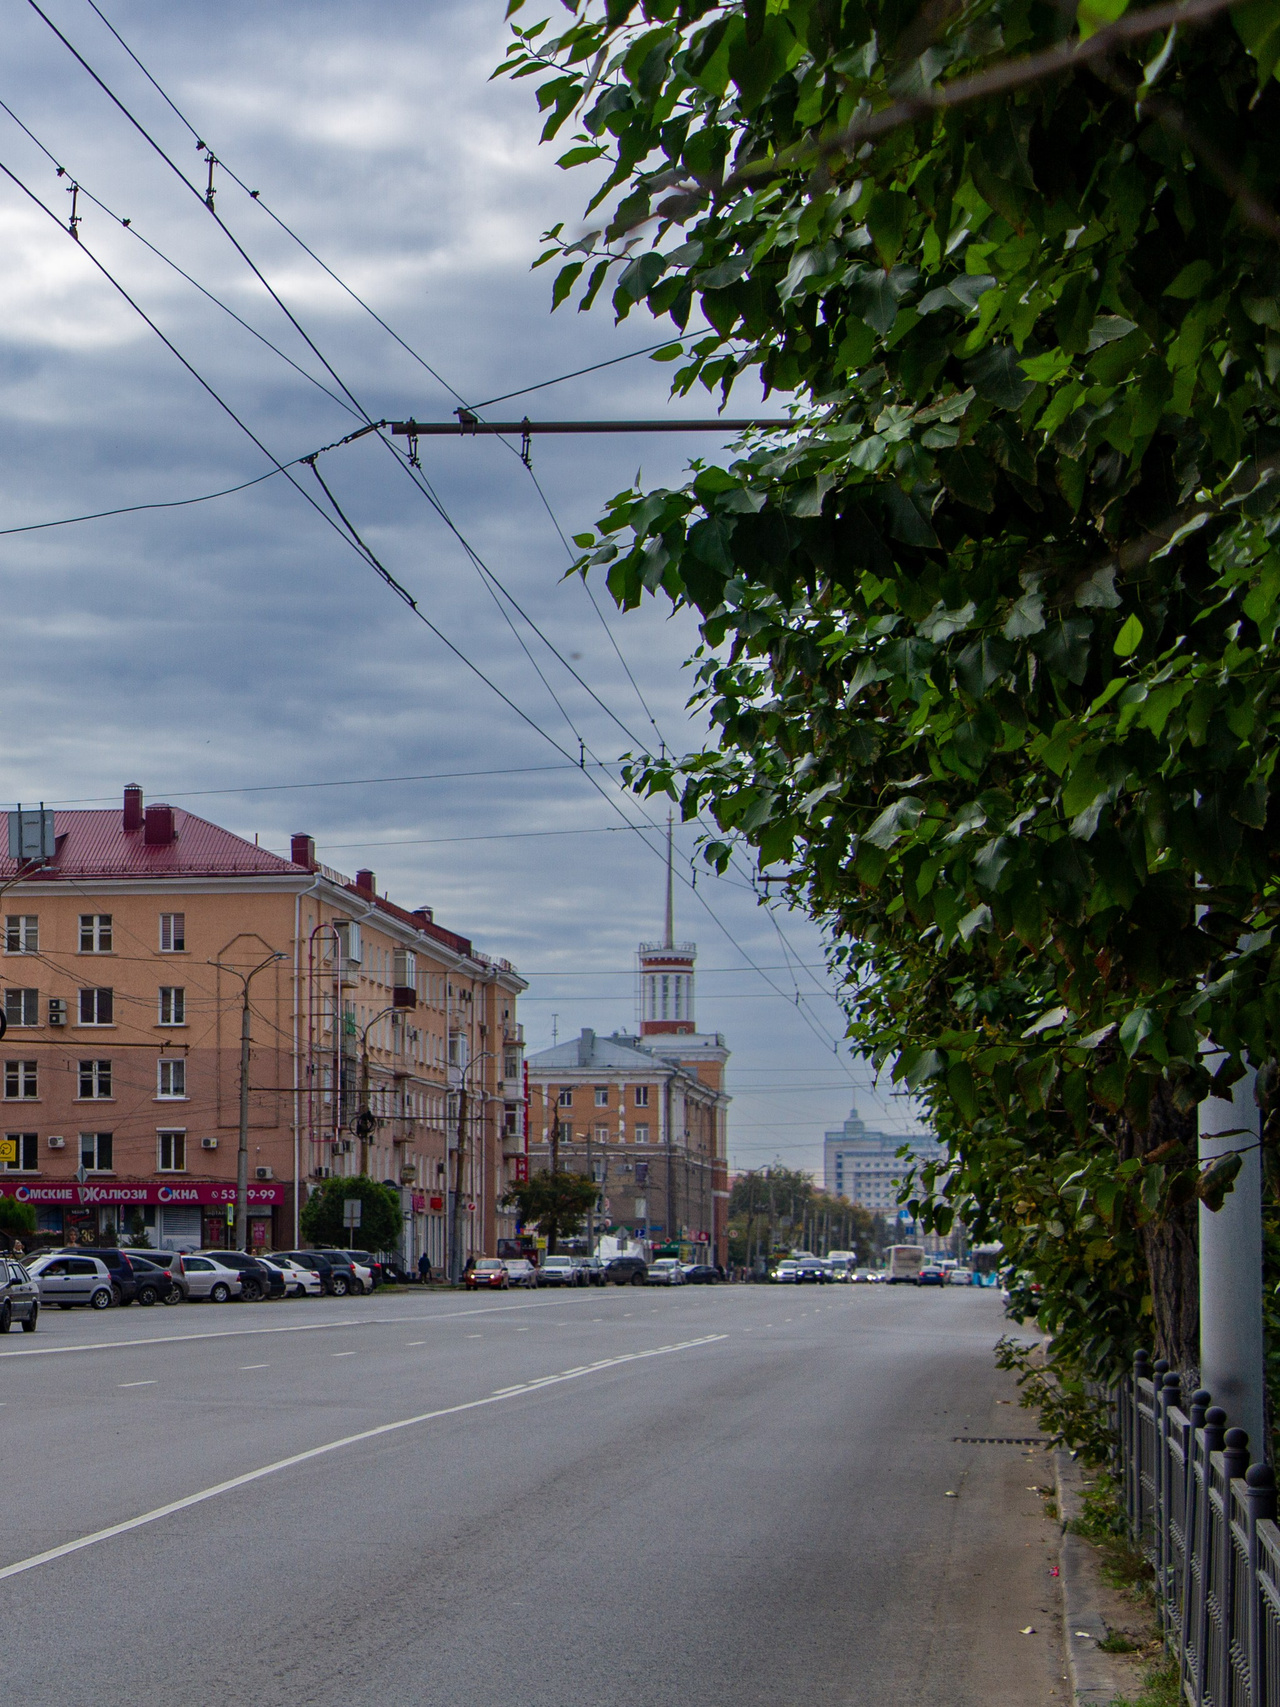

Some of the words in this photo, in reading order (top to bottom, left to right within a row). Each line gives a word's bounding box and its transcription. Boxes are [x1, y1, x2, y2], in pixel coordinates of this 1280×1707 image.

[15, 1186, 73, 1202] ОМСКИЕ
[82, 1186, 147, 1202] ЖАЛЮЗИ
[158, 1187, 199, 1202] ОКНА
[221, 1189, 276, 1200] 53-9-99
